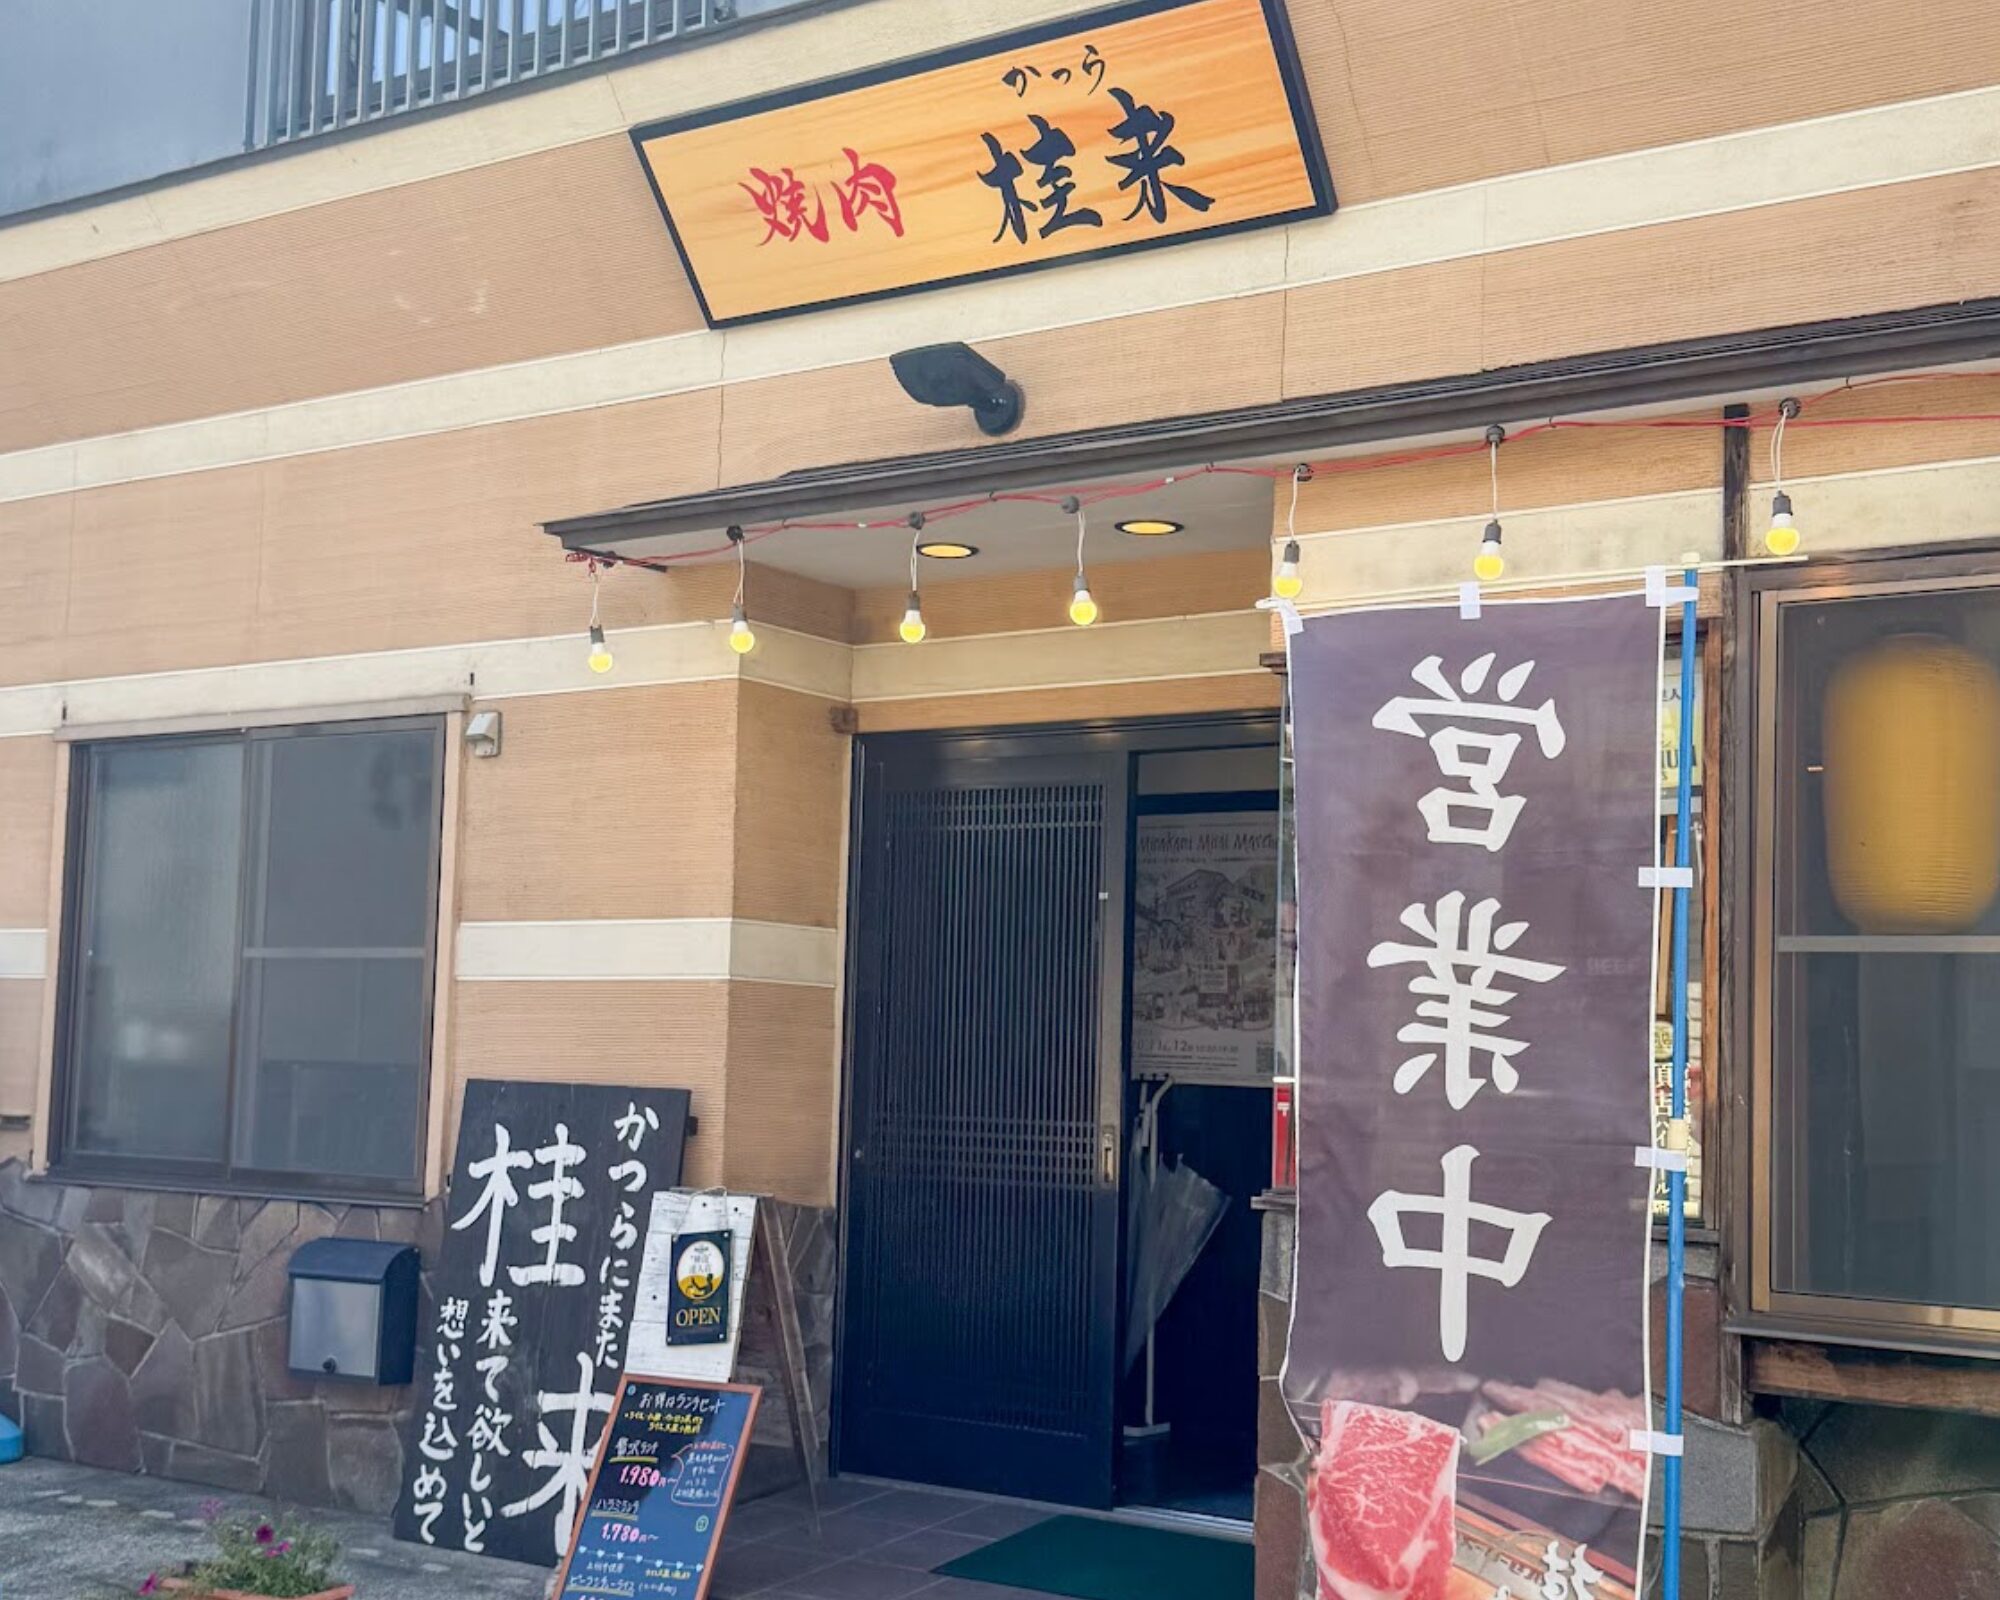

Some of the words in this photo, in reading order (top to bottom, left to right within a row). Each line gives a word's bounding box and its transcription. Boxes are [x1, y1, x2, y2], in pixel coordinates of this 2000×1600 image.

[739, 147, 904, 246] 焼肉
[977, 87, 1216, 245] 桂来
[1367, 651, 1567, 1363] 営業中
[594, 1101, 661, 1369] かつらにまた
[675, 1307, 721, 1327] OPEN
[413, 1297, 469, 1544] 想いを込めて
[461, 1290, 518, 1553] 来て欲しいと
